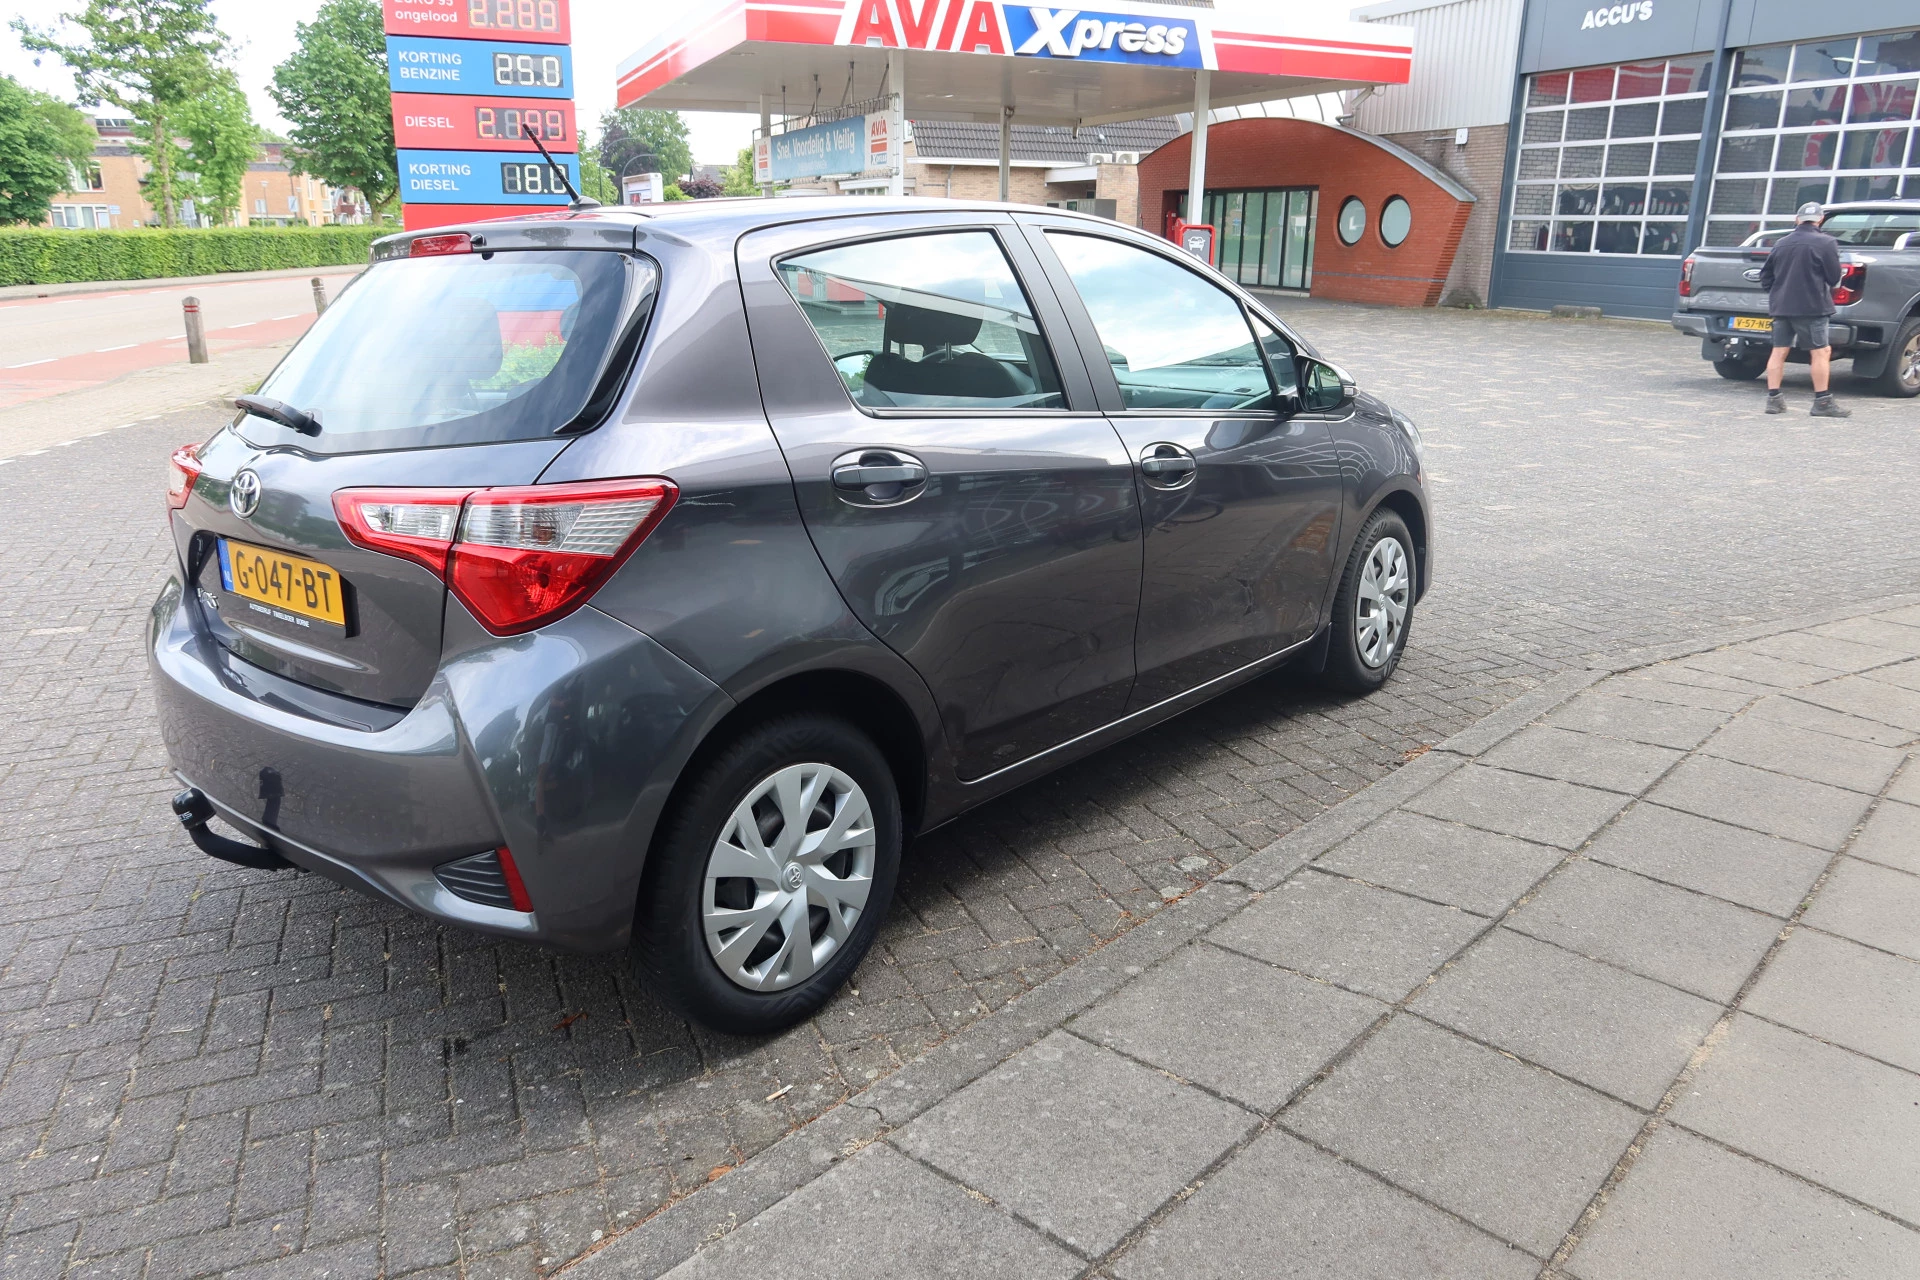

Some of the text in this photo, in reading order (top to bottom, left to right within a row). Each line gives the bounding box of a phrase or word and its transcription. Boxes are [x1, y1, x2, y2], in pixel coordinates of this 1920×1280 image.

[395, 10, 458, 23] ongelood
[1580, 0, 1654, 31] ACCU'S
[849, 0, 1188, 57] AVIA Xpress
[398, 51, 463, 65] KORTING
[495, 54, 561, 87] 25.0
[400, 67, 461, 81] BENZINE
[404, 115, 454, 128] DIESEL
[478, 108, 564, 140] 2.199
[871, 116, 887, 137] AVIA
[776, 128, 855, 160] Snel, Voordelig & Veilig
[409, 164, 471, 176] KORTING
[515, 164, 568, 194] 18.0
[410, 179, 460, 191] DIESEL
[236, 550, 331, 613] G-047-BT
